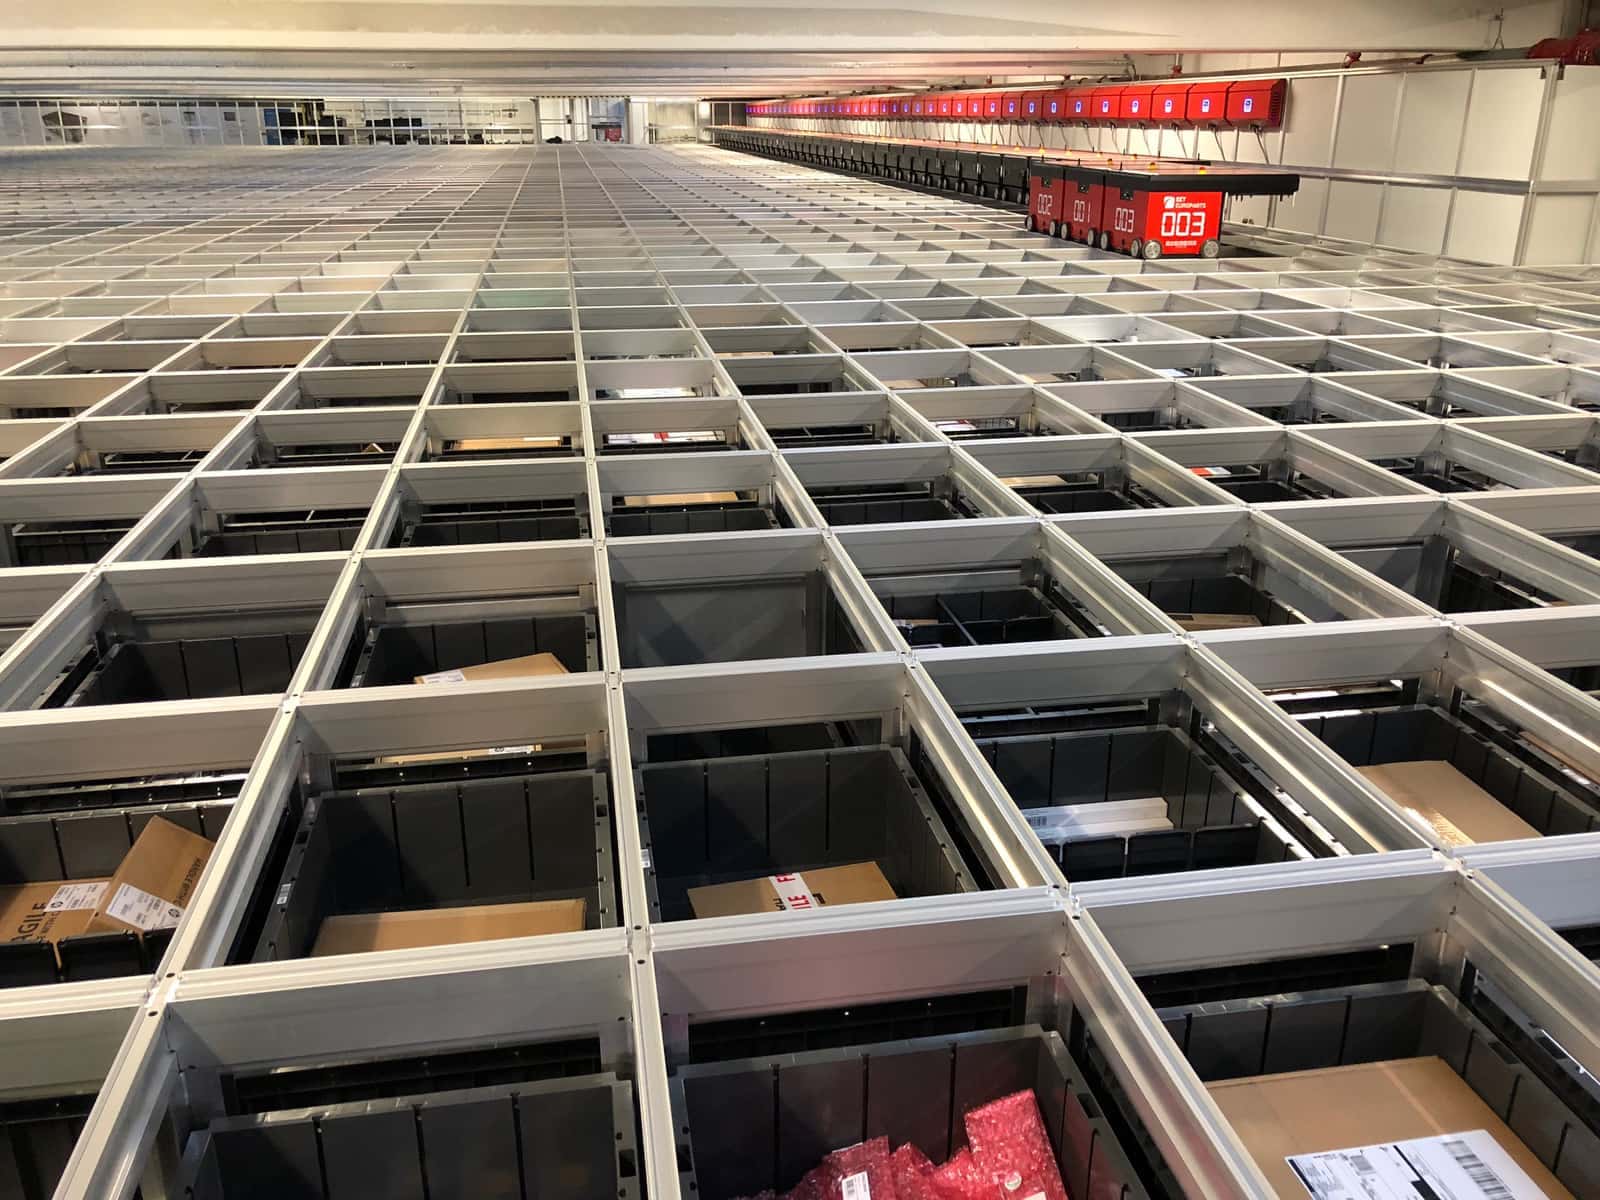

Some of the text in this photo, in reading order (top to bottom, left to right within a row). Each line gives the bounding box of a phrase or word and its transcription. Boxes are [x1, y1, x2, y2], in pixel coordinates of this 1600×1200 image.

[1037, 193, 1053, 216] 002
[1073, 200, 1091, 223] 001
[1114, 207, 1135, 233] 003
[1161, 212, 1206, 237] 003
[10, 902, 48, 941] AGILE
